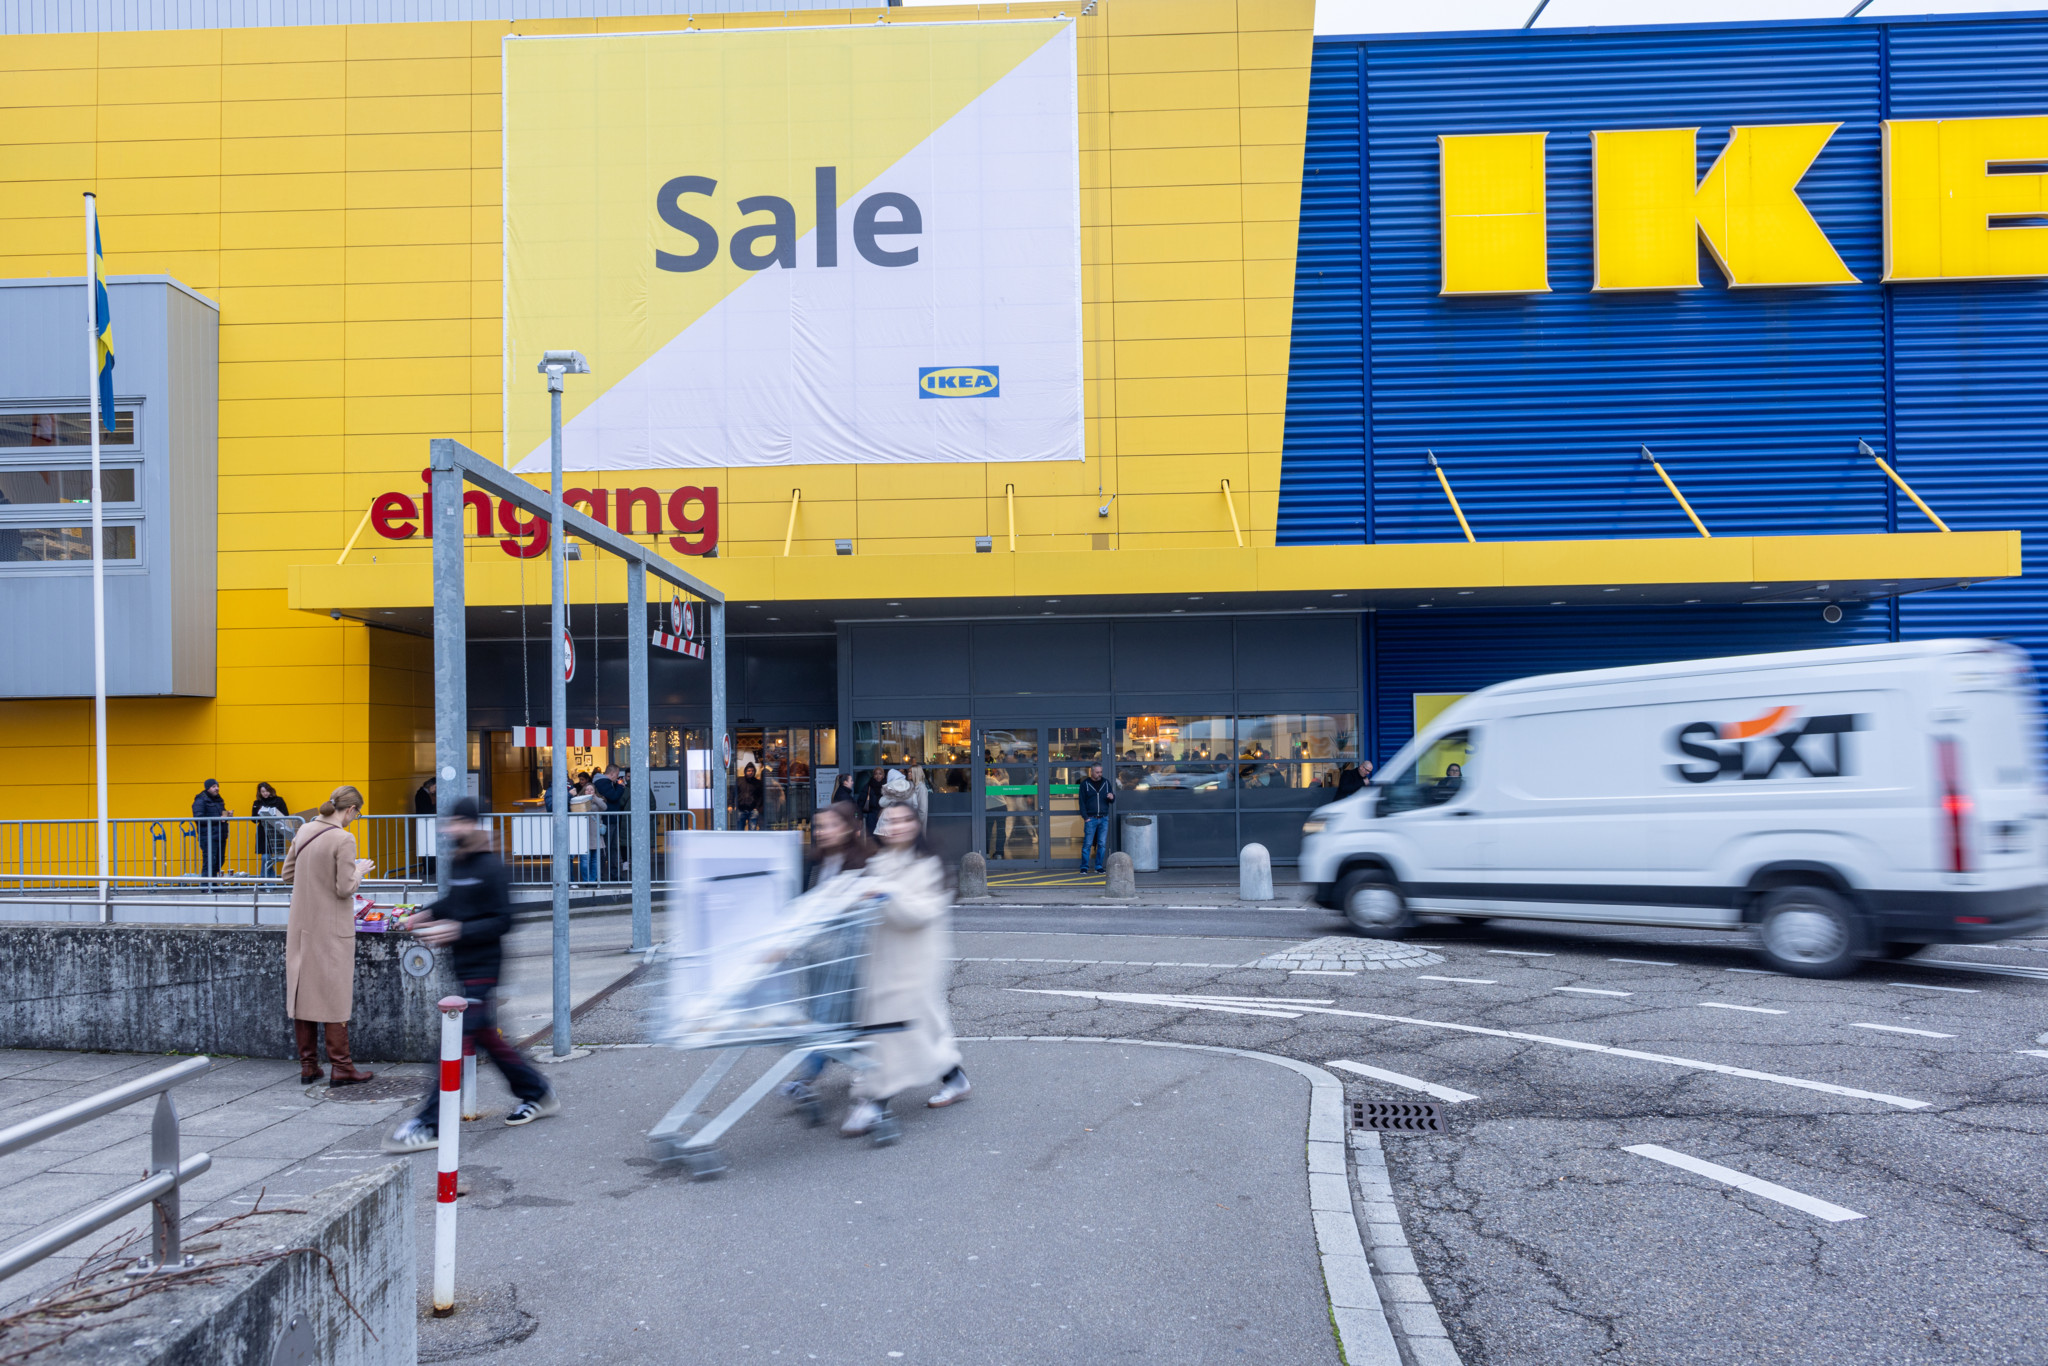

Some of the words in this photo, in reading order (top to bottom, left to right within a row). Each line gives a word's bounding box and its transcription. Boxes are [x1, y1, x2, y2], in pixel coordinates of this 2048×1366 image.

[655, 165, 923, 273] Sale
[1436, 115, 2048, 295] IKE
[927, 375, 993, 389] IKEA
[1665, 707, 1873, 783] SIXT
